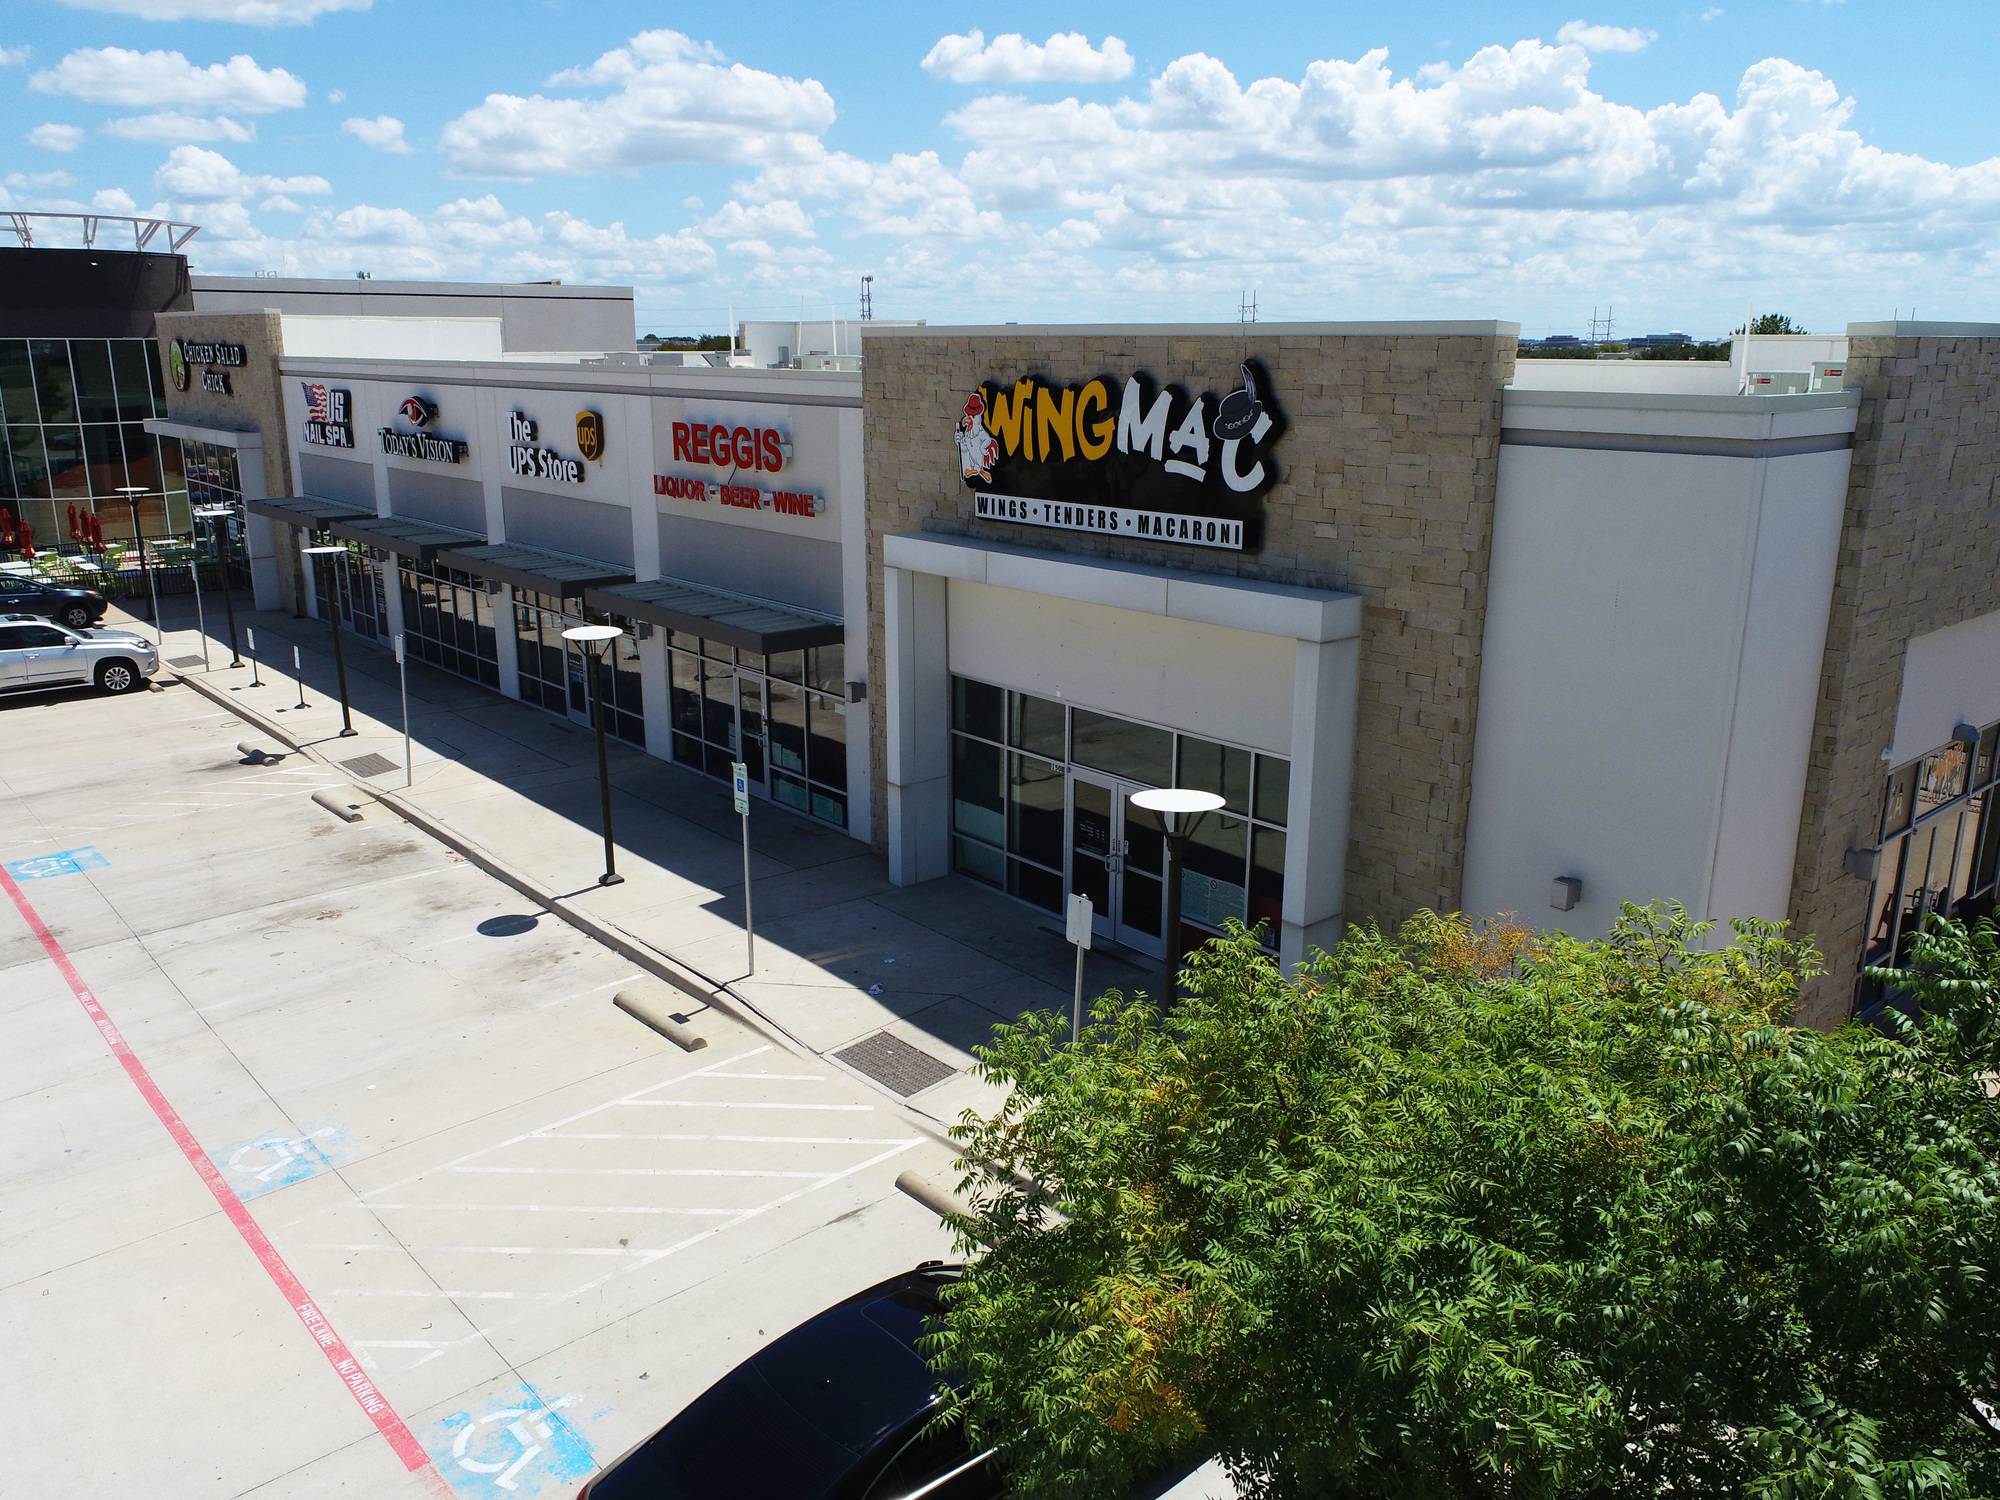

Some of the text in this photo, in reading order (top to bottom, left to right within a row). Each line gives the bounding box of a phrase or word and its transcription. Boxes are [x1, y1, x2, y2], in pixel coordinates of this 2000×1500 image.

[183, 342, 240, 365] CHICKEN SALAD
[201, 370, 225, 394] CHICK
[303, 421, 325, 444] NAIL
[505, 410, 532, 442] The
[578, 426, 596, 453] ups
[377, 428, 455, 464] TODAY'S VISION
[671, 421, 783, 473] REGGIS
[508, 446, 579, 483] UPS Store
[653, 474, 707, 502] LIQUOR
[719, 484, 763, 511] BEER
[772, 490, 816, 518] WINE
[976, 496, 1241, 545] WINGS TENDERS MACARONI
[296, 1303, 337, 1347] FIRE LANE
[336, 1359, 385, 1415] NO PARKING
